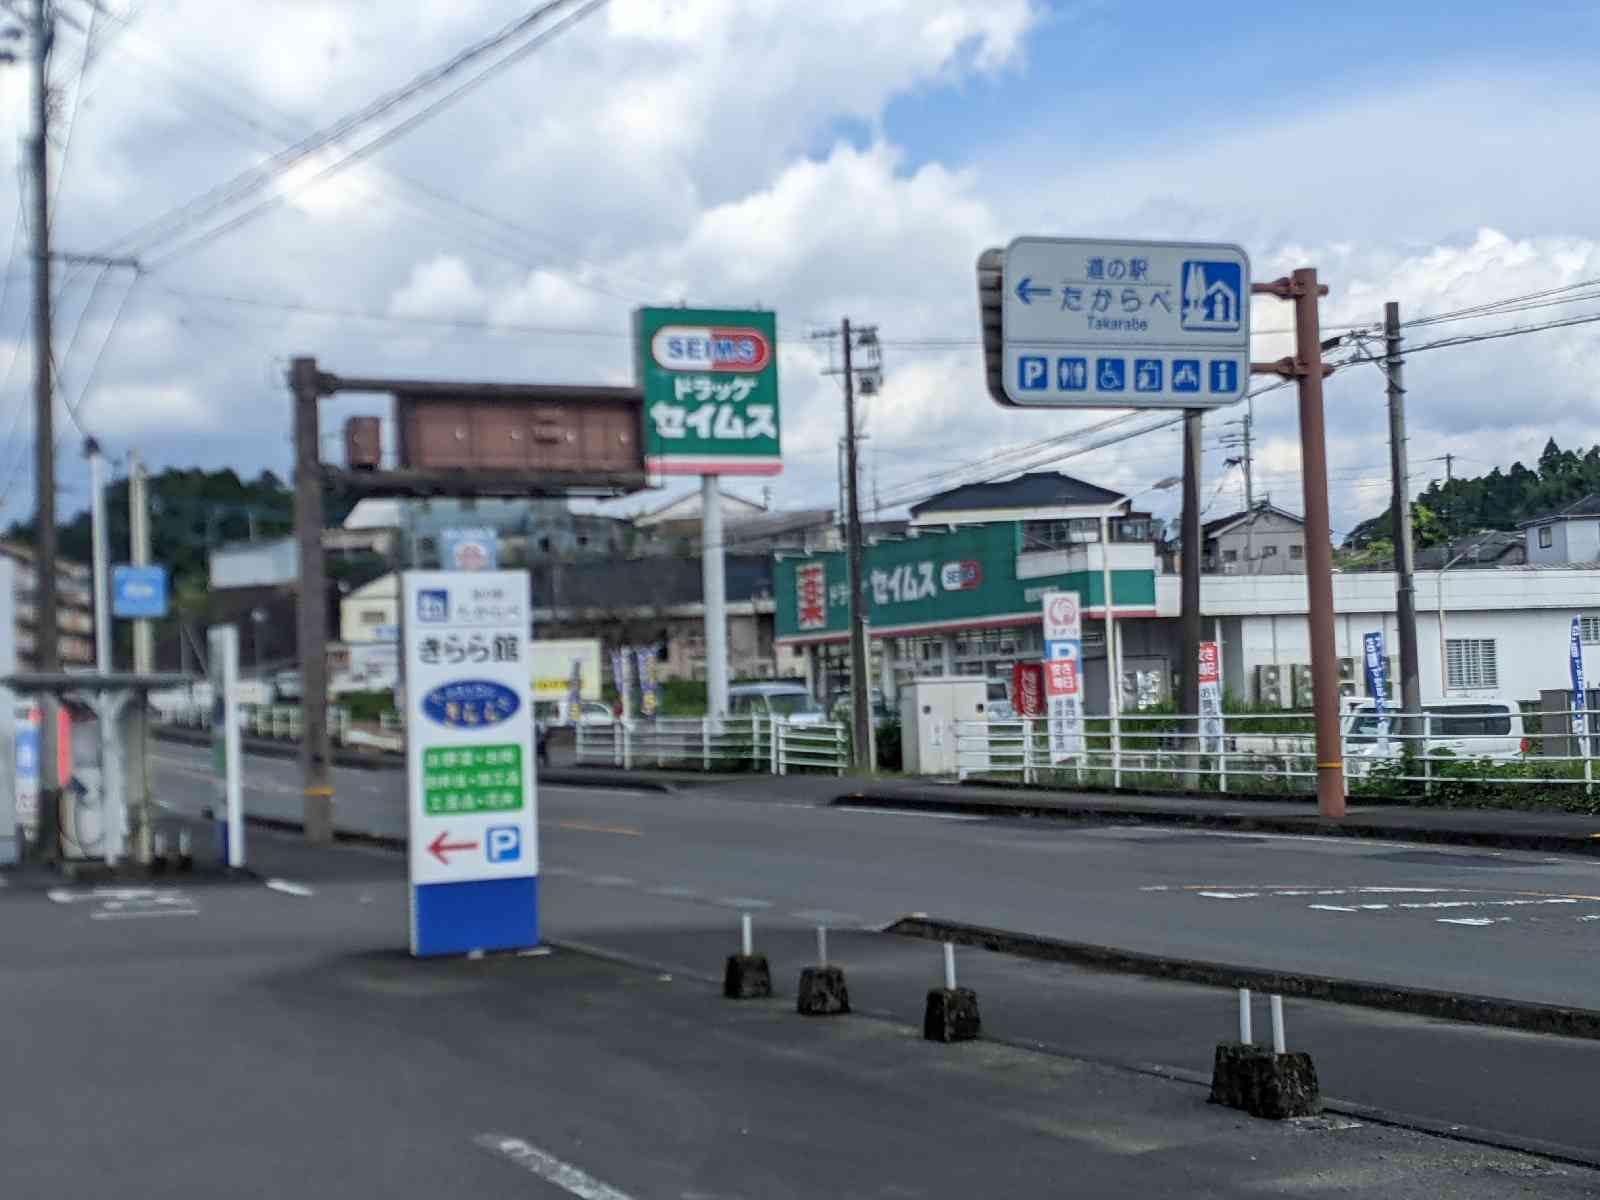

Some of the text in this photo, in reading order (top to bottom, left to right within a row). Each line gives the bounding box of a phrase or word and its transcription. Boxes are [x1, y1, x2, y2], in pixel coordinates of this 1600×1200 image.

[1087, 256, 1148, 280] 道の駅
[1061, 287, 1172, 313] たからべ
[1087, 315, 1149, 332] Takarabe
[667, 336, 756, 362] SEIMS
[673, 375, 759, 402] ドラッグ
[650, 401, 777, 439] セイムス
[870, 560, 938, 605] セイムス
[419, 633, 520, 664] きらら館
